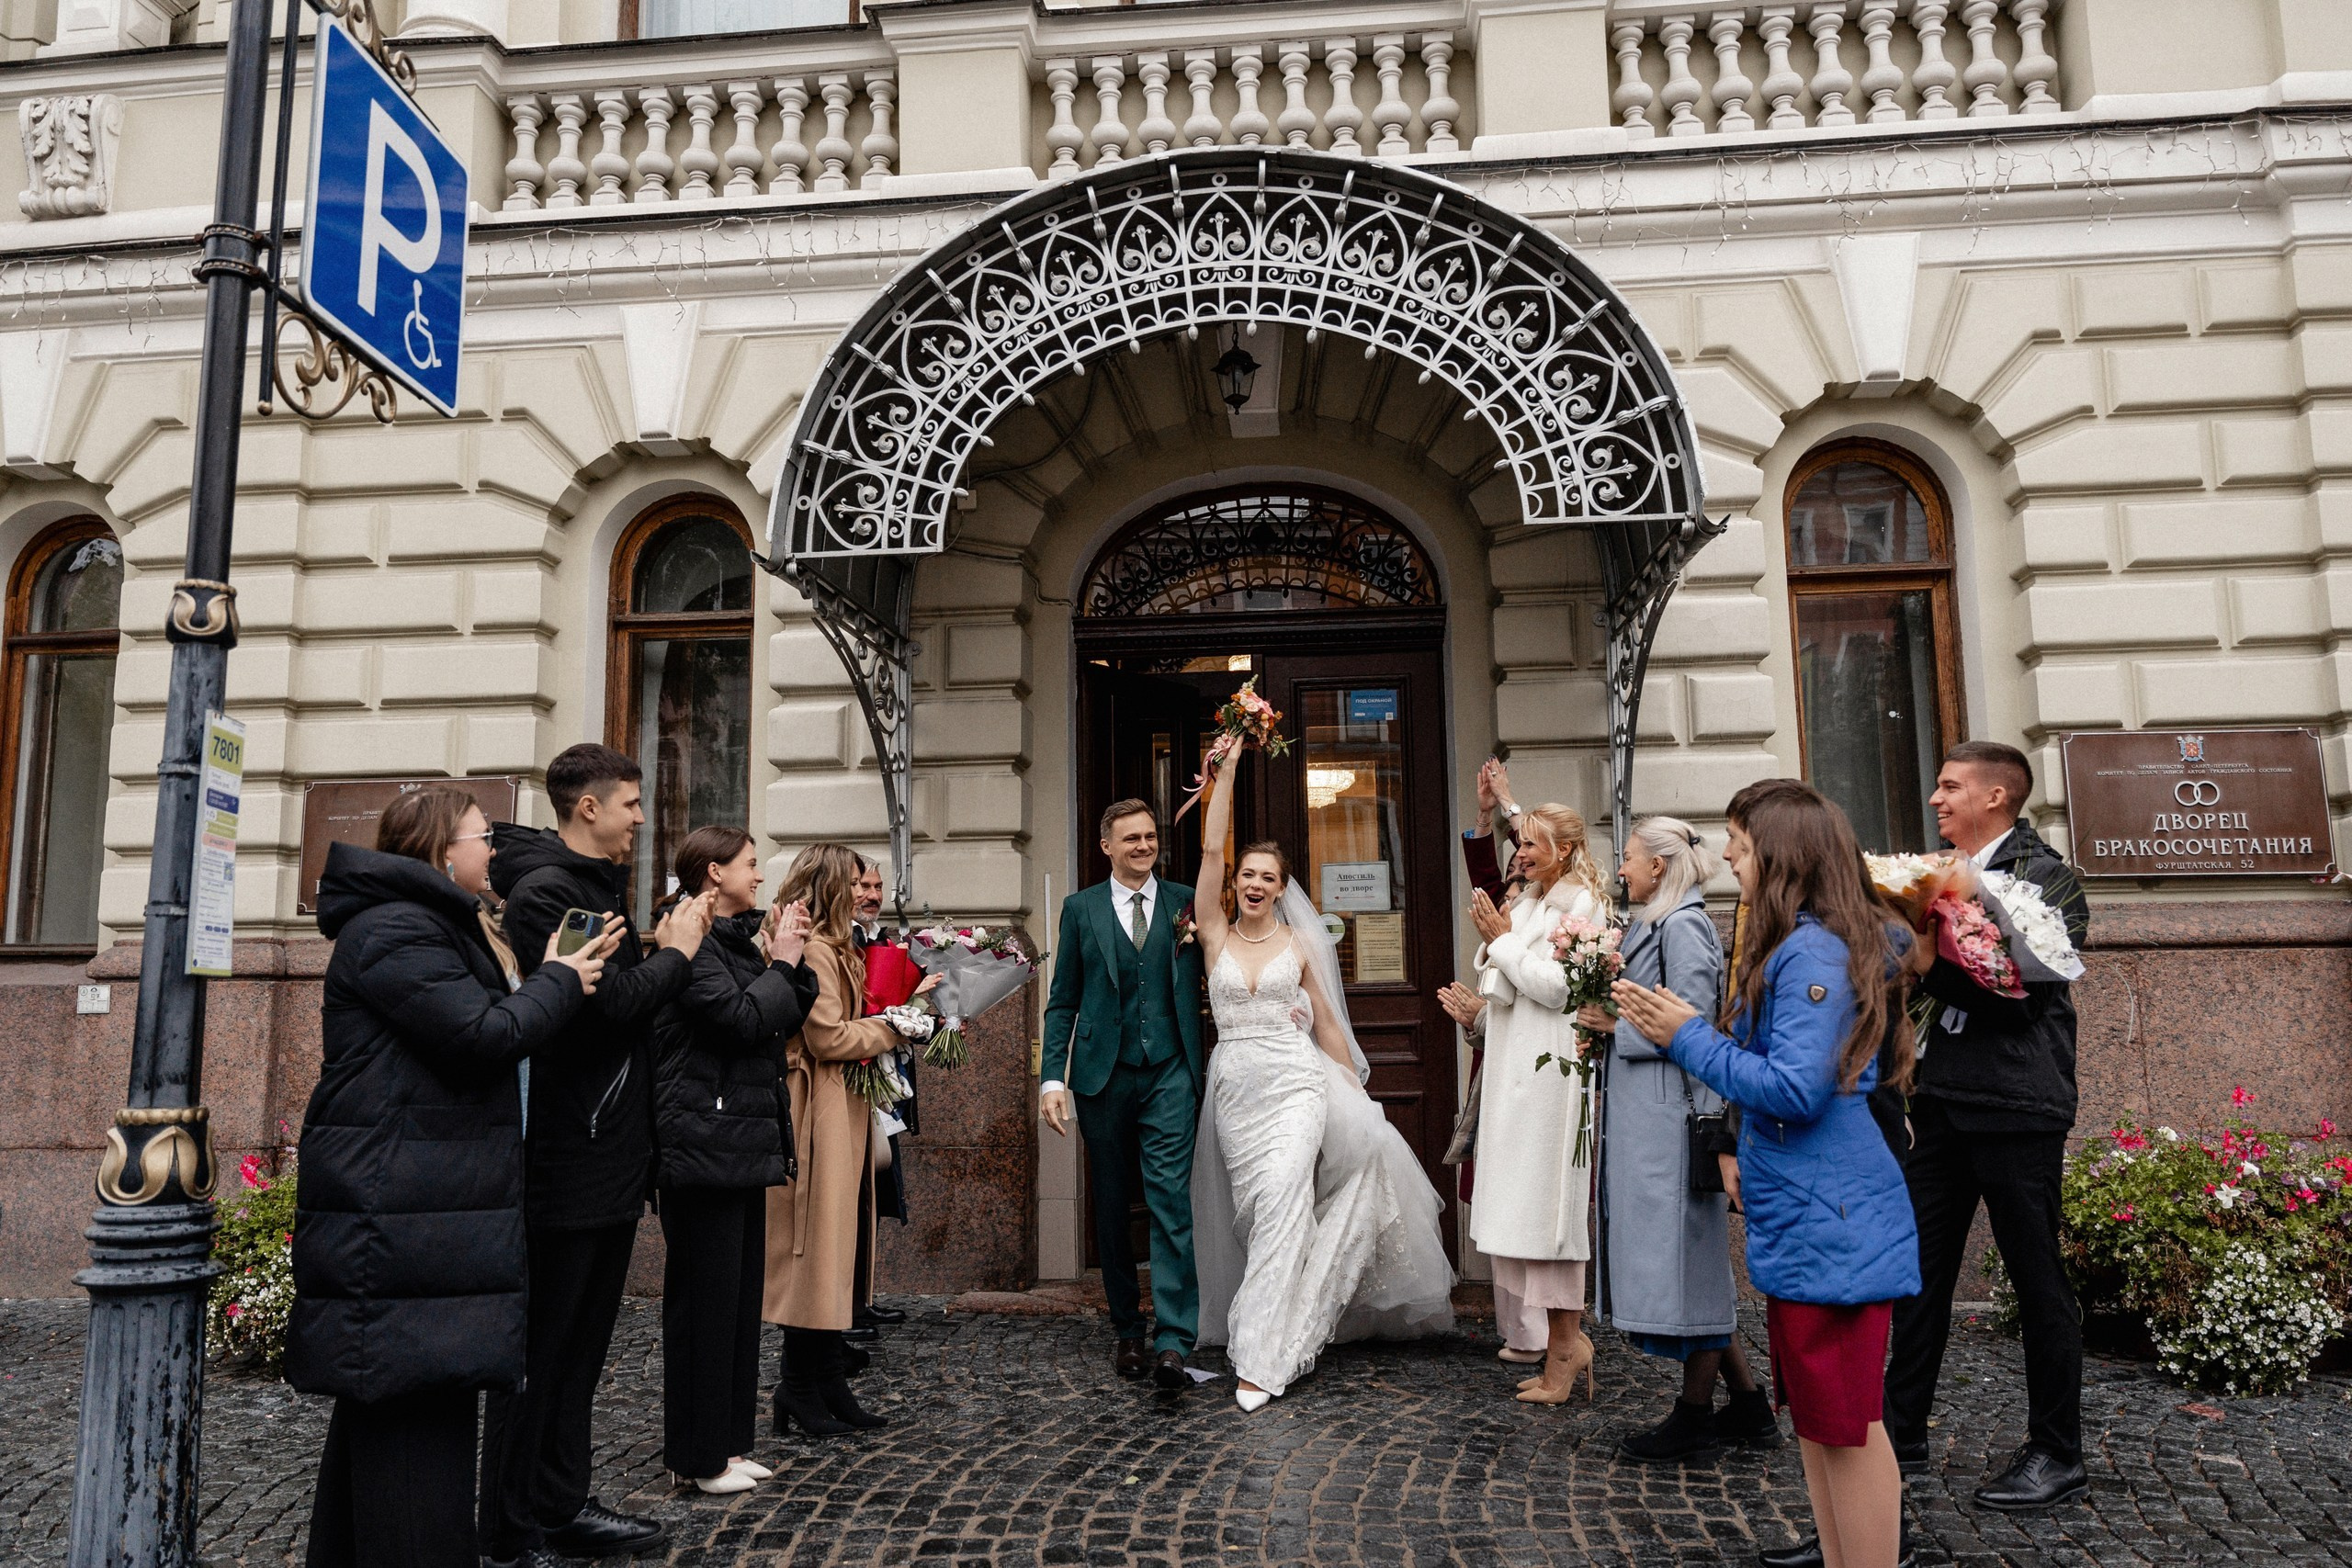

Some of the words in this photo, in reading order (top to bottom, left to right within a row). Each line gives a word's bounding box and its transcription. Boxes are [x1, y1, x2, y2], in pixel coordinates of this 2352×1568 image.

[357, 97, 443, 317] P
[213, 735, 240, 764] 7801
[2154, 813, 2250, 832] ДВОРЕЦ
[2094, 837, 2313, 857] БРАКОСОЧЕТАНИЯ
[2240, 860, 2255, 869] 52
[1351, 885, 1374, 893] дворе
